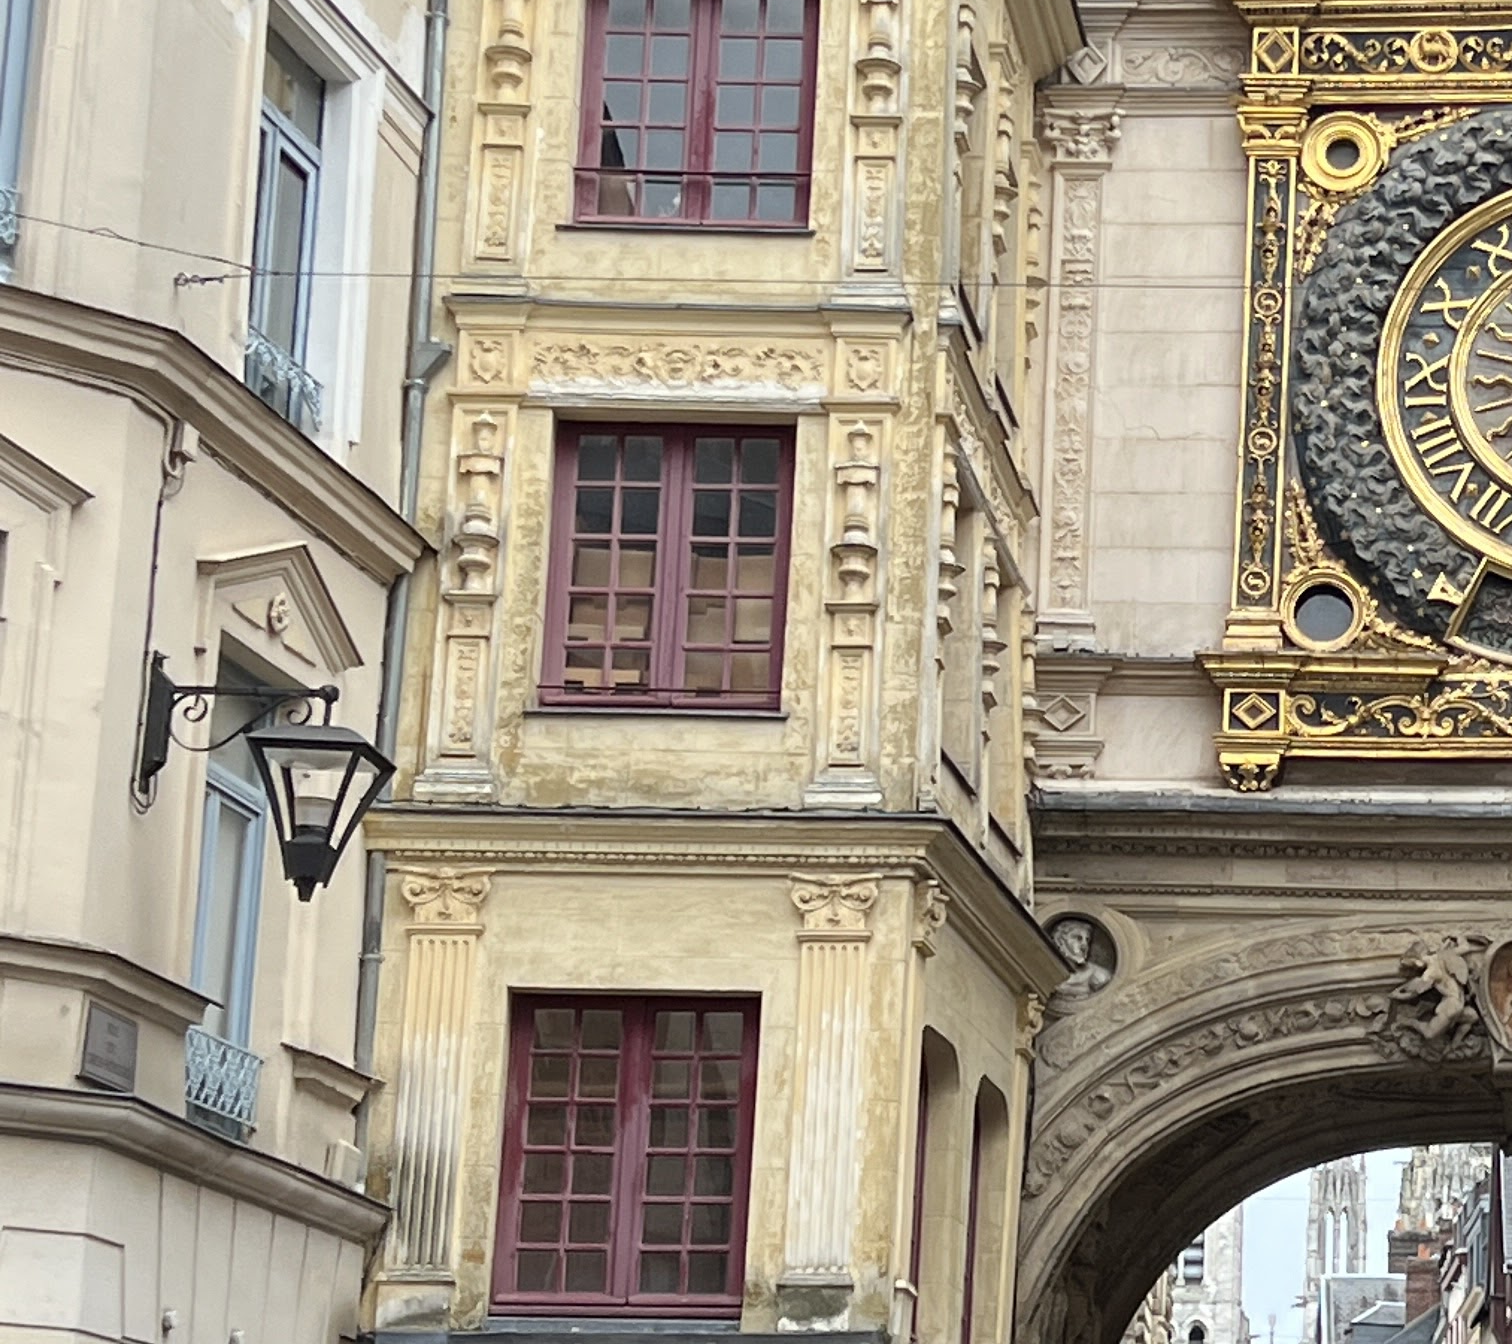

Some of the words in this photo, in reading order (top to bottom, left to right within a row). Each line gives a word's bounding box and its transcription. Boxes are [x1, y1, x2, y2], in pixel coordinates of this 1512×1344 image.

[1420, 277, 1478, 331] X
[1404, 352, 1453, 408] IX
[1410, 416, 1475, 503] VIII
